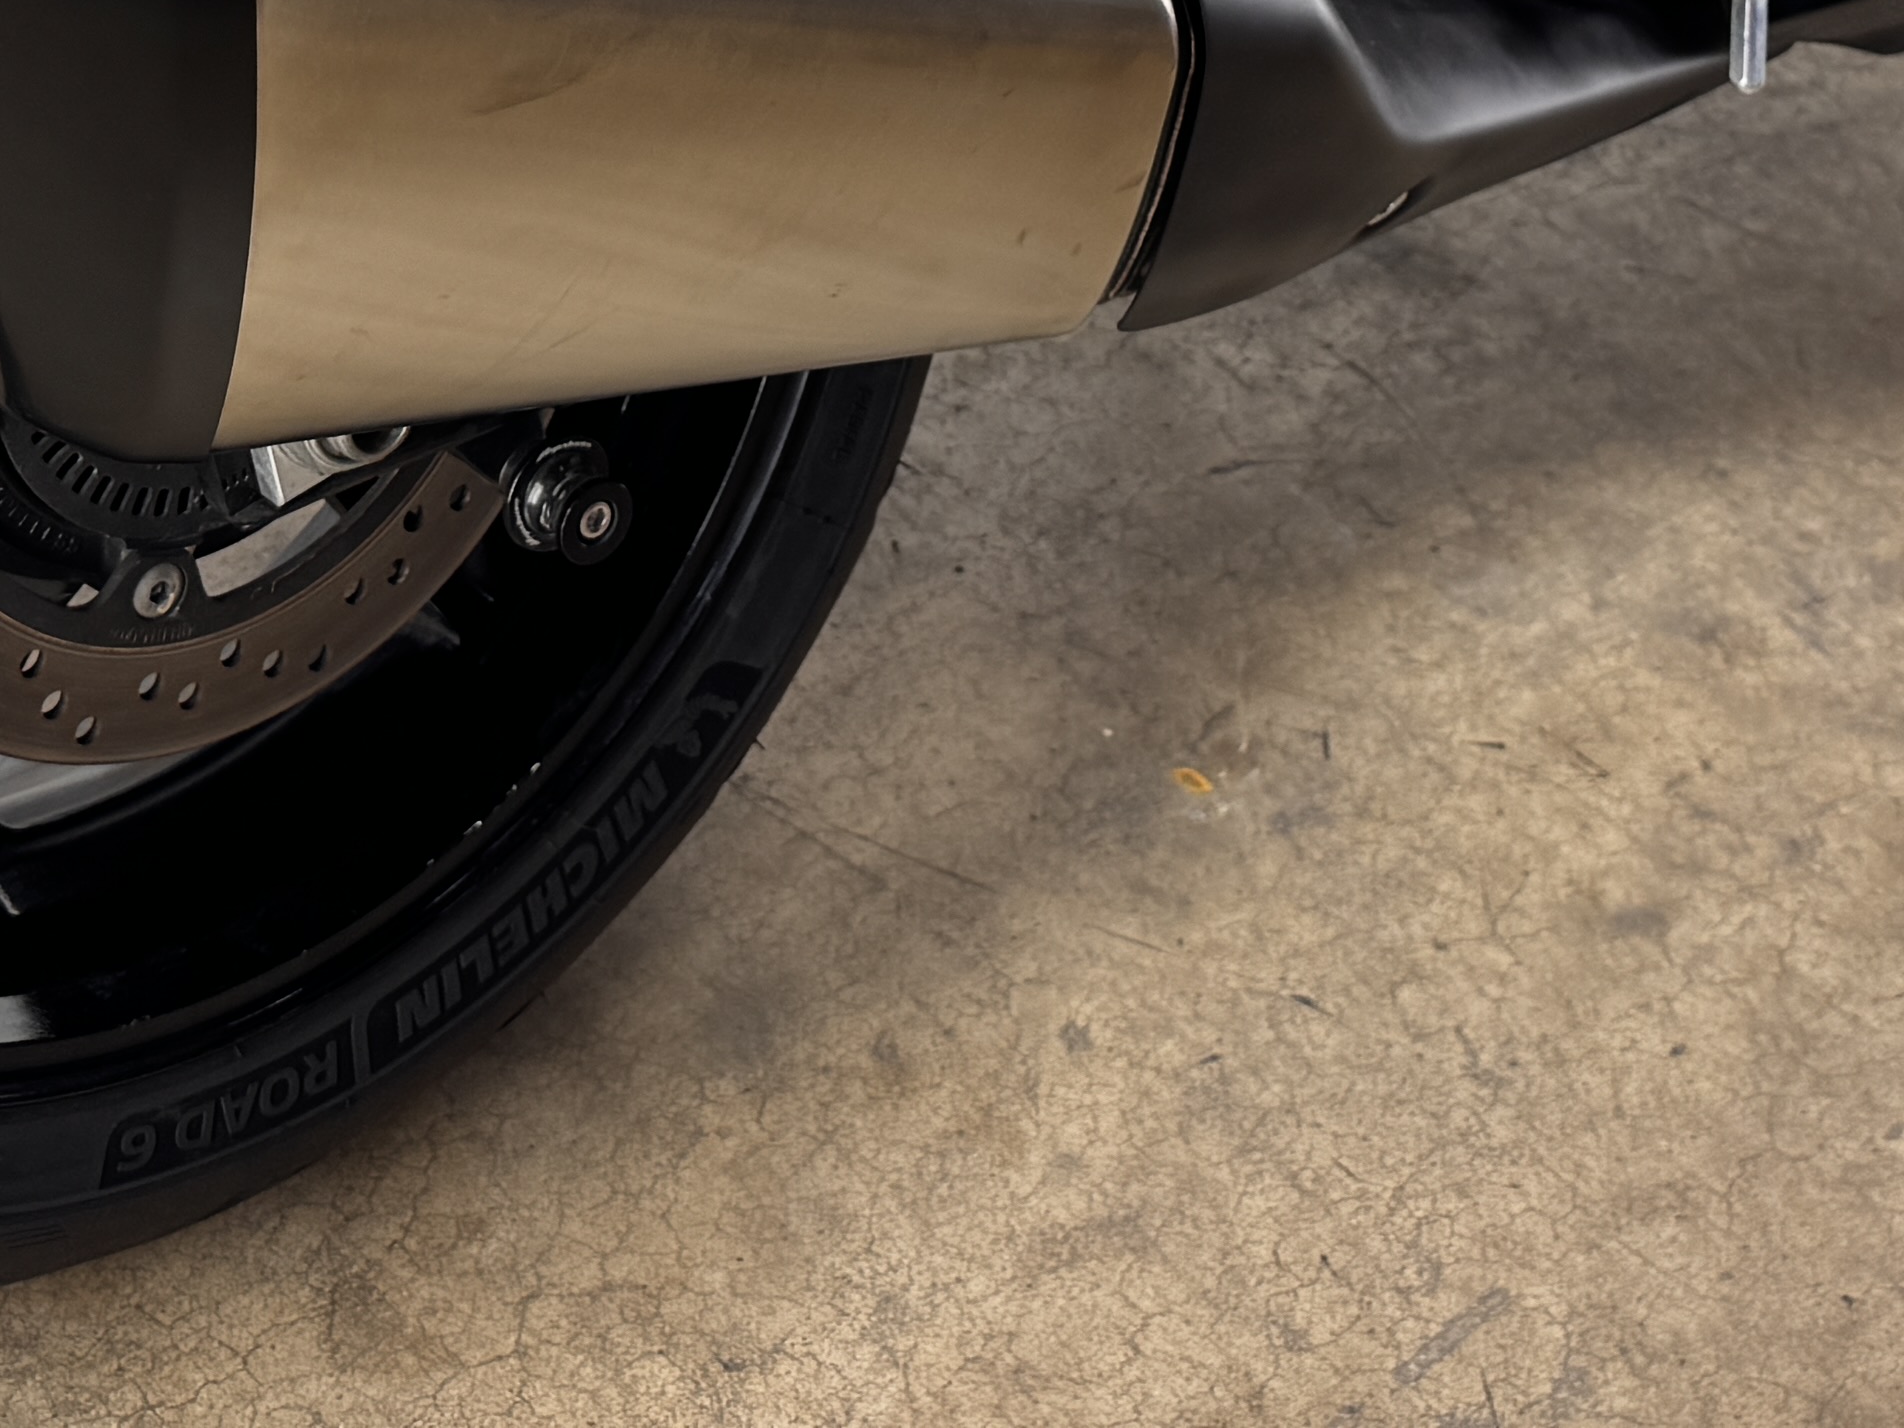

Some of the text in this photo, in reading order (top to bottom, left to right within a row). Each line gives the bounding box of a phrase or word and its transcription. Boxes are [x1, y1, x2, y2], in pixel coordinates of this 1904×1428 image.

[395, 761, 669, 1042] MICHELIN
[115, 1039, 339, 1174] ROAD 6
